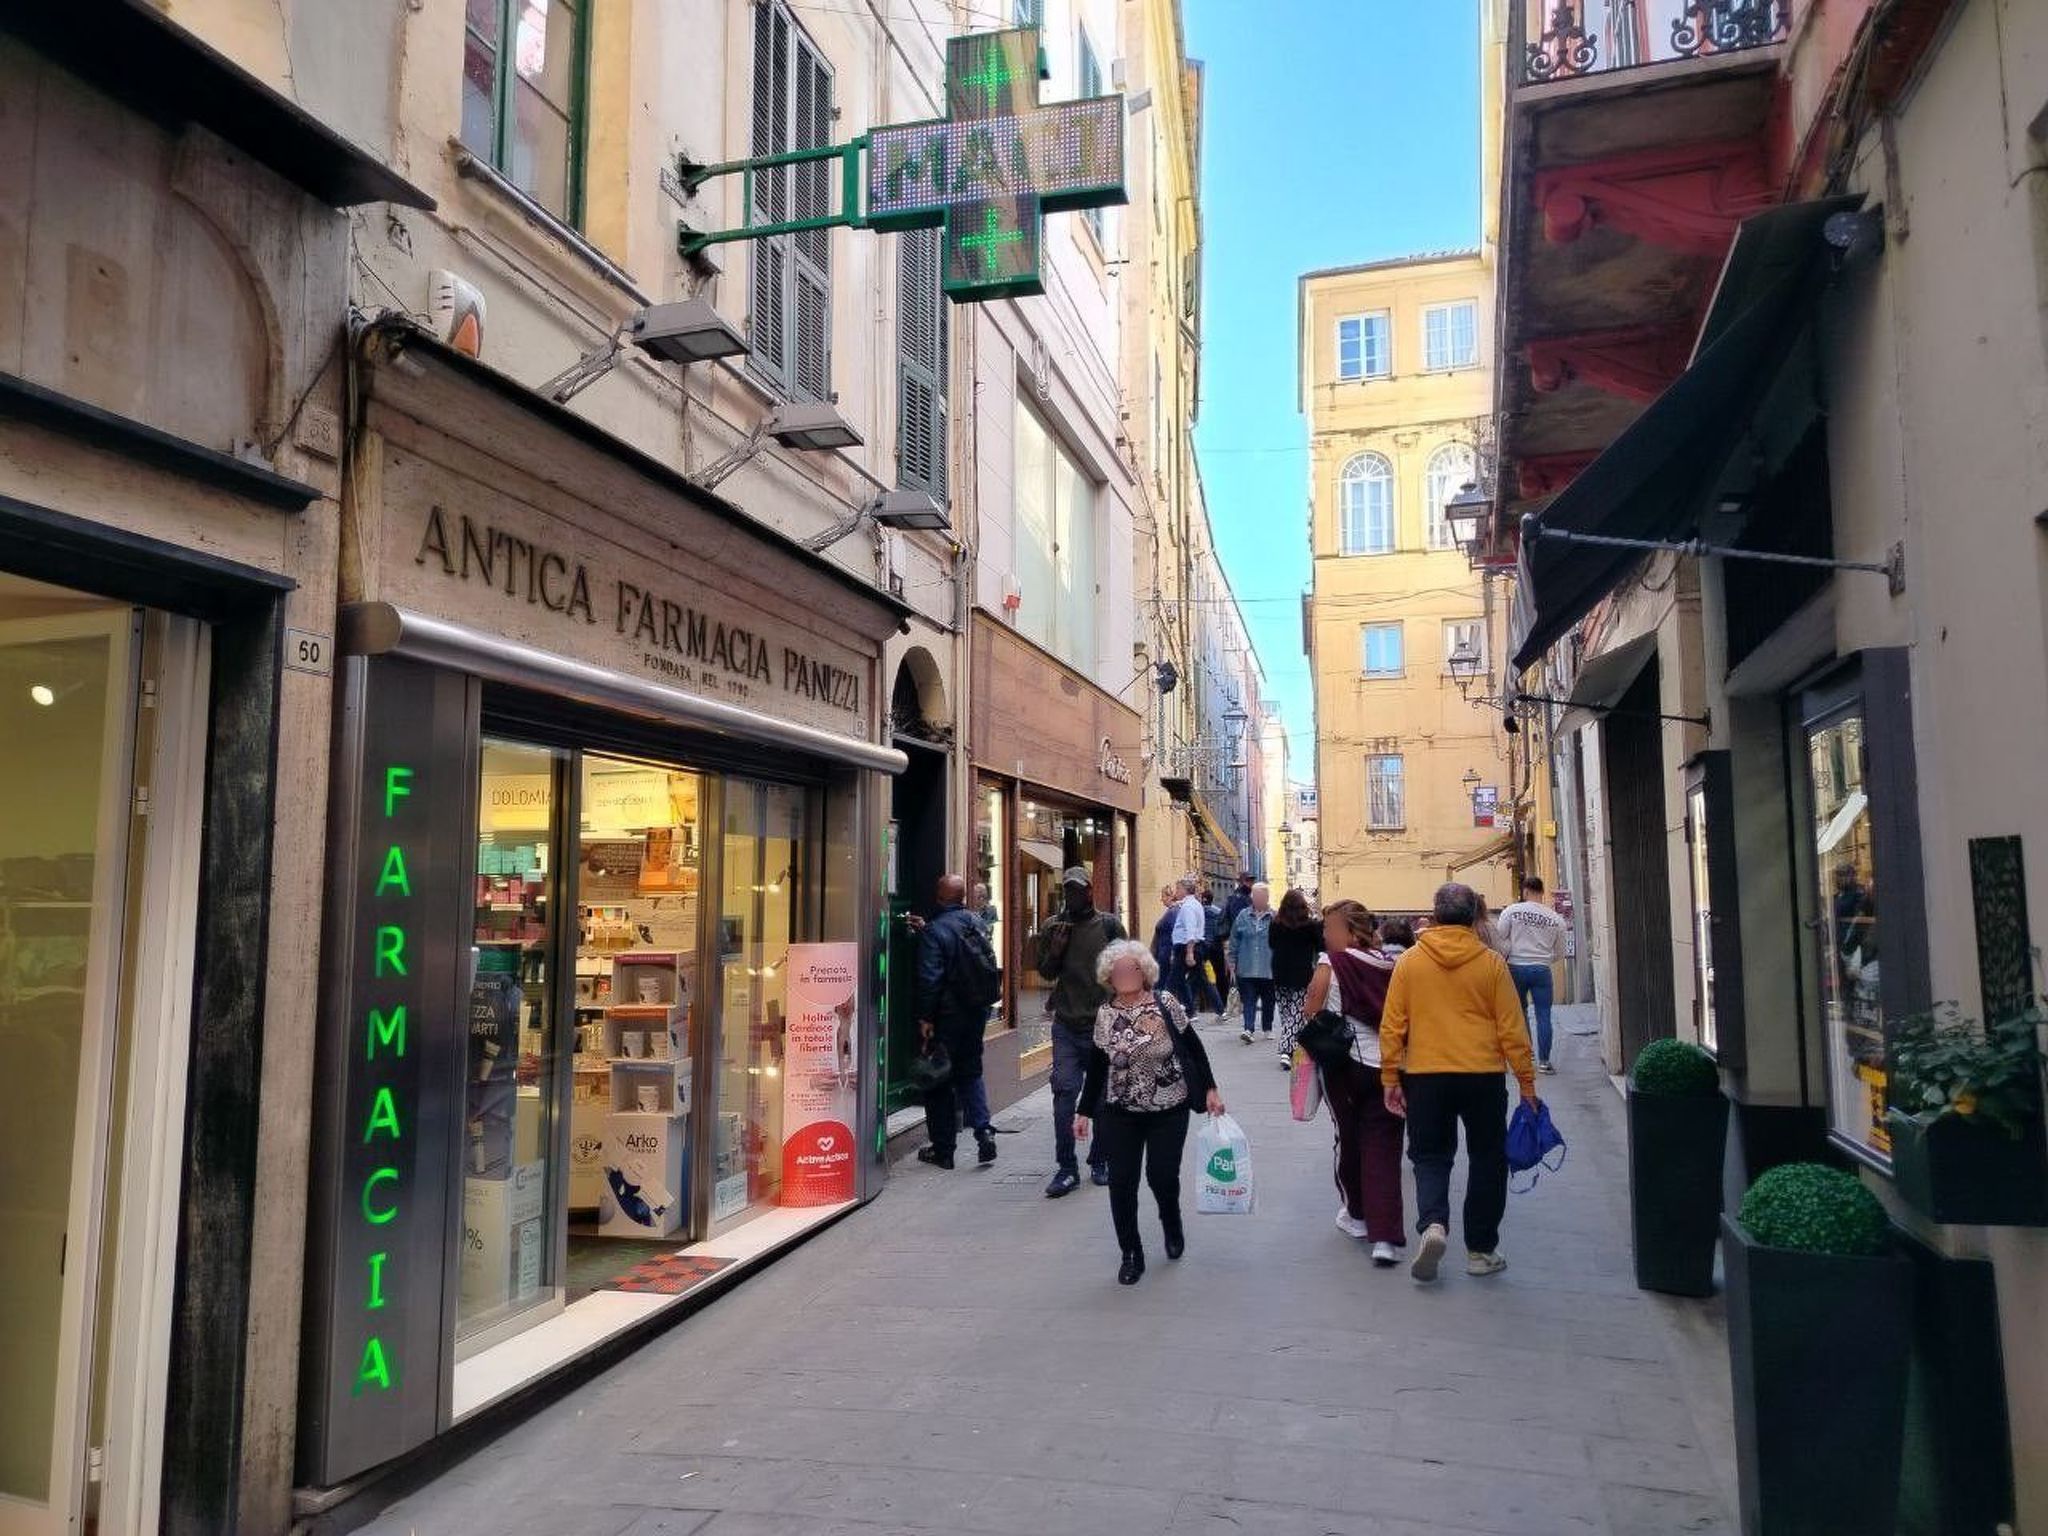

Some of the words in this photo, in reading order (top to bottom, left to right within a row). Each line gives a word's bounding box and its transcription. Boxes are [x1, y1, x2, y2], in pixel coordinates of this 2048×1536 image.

[415, 505, 596, 624] ANTICA
[615, 579, 771, 684] FARMACIA
[784, 647, 860, 713] PANIZZI
[299, 640, 320, 663] 60
[644, 653, 692, 681] FONDATA
[352, 767, 415, 1392] FARMACIA
[625, 1134, 658, 1148] Arko
